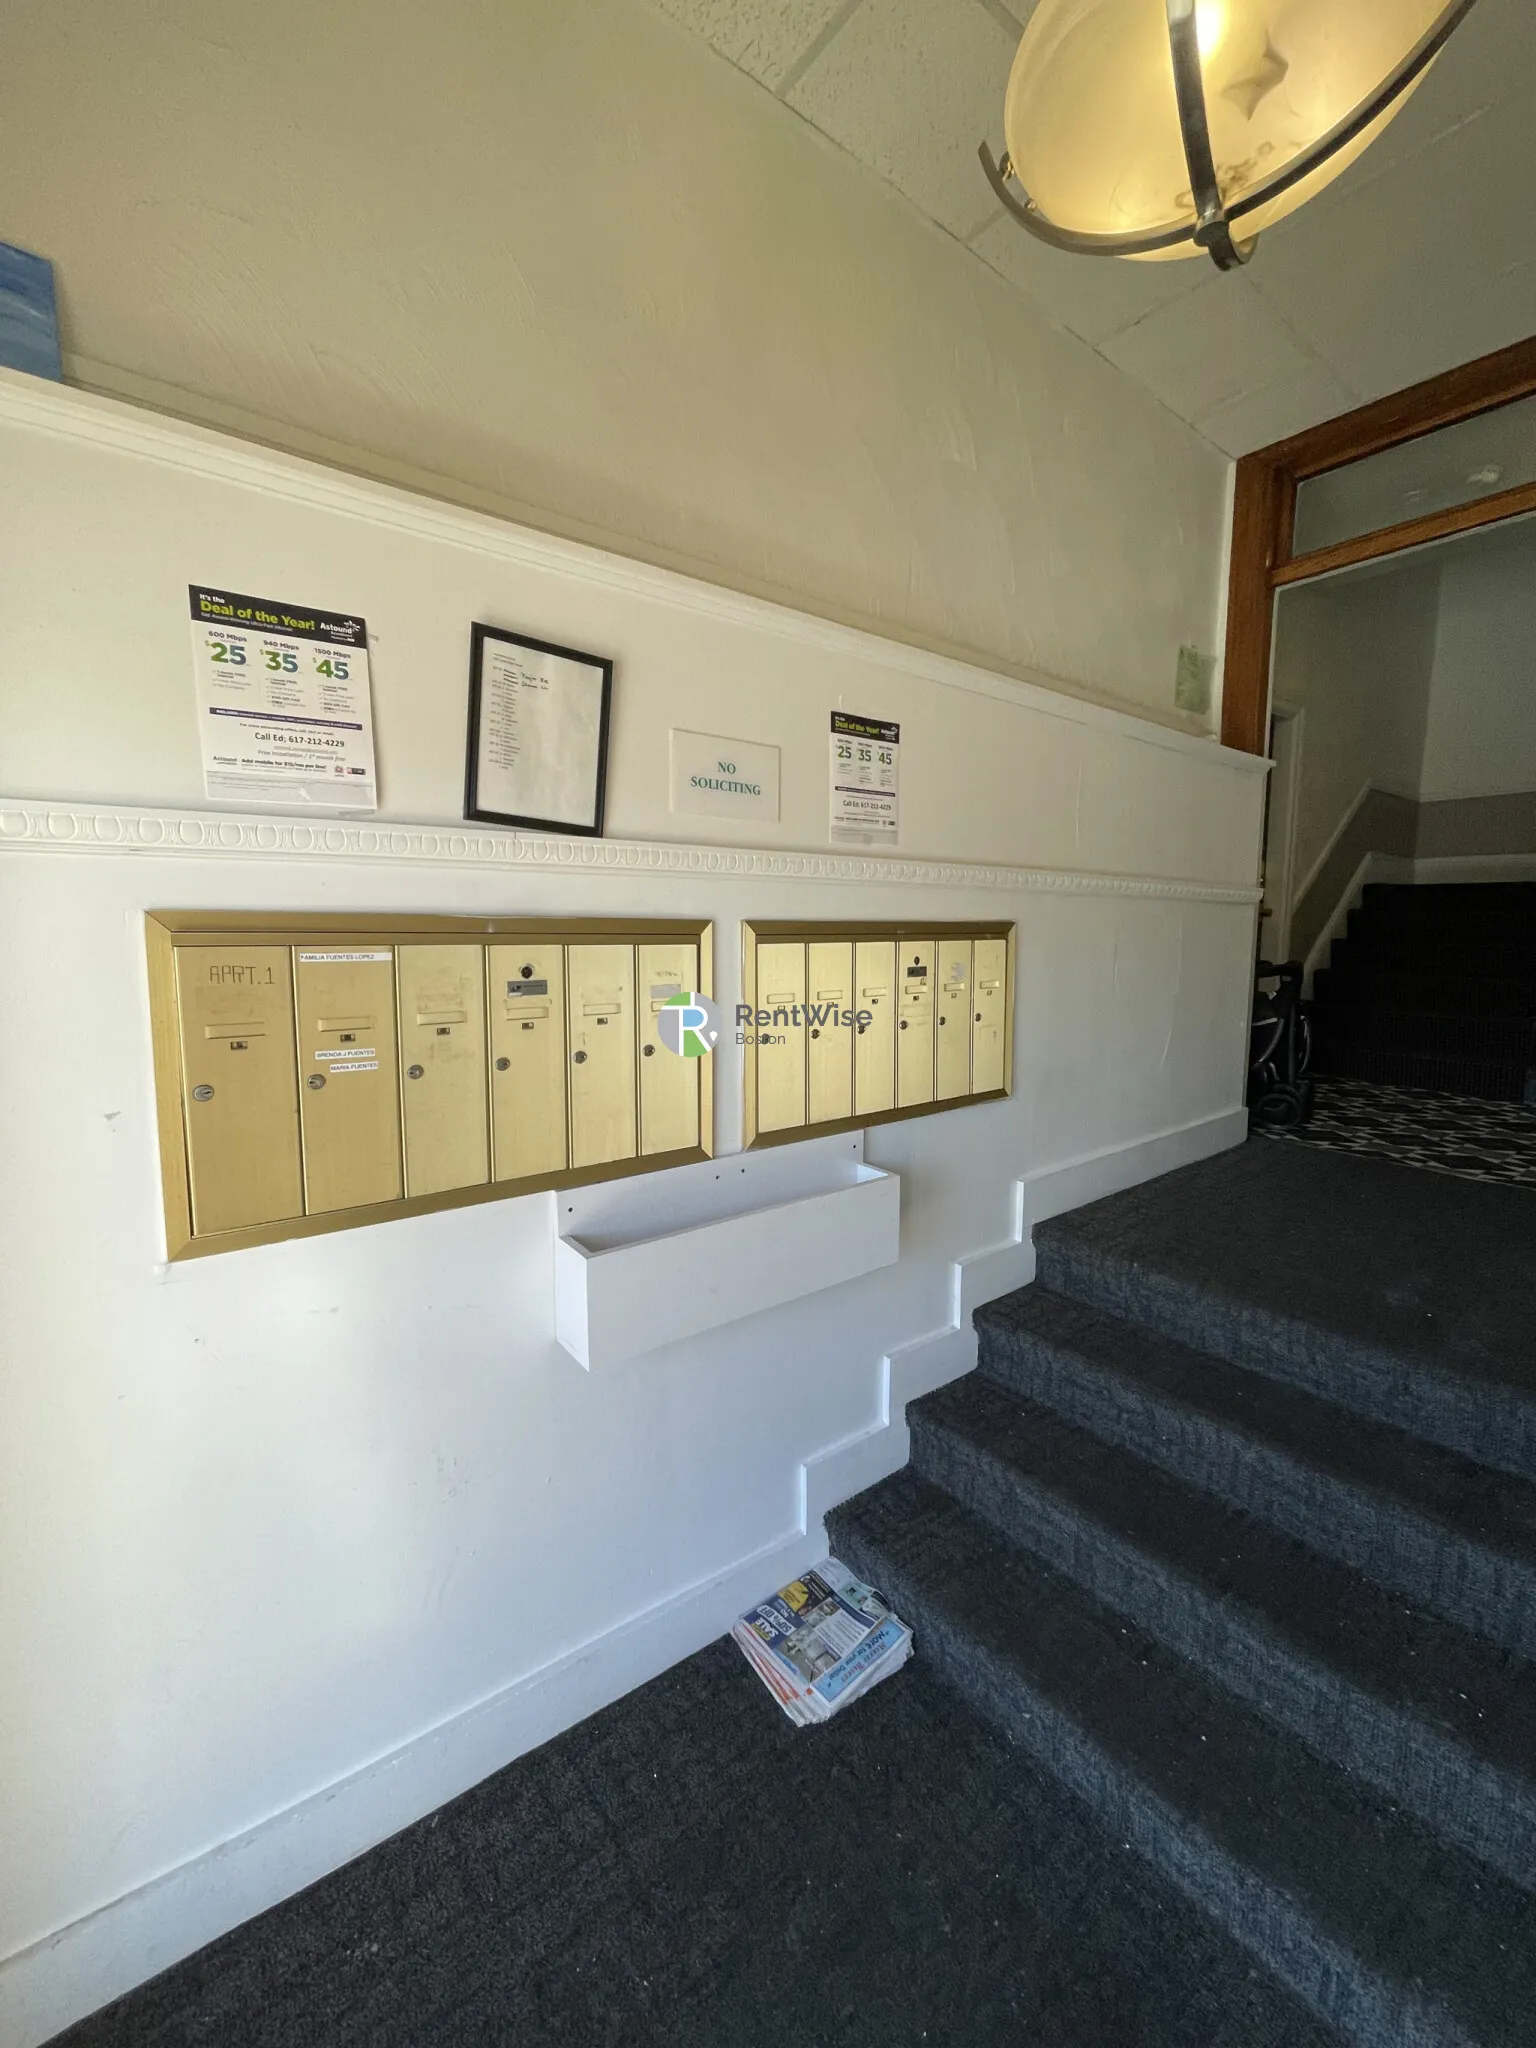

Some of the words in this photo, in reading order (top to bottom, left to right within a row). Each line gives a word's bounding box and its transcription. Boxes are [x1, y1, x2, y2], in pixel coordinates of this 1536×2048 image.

[200, 593, 211, 602] It's
[212, 596, 225, 604] the
[201, 600, 234, 616] Deal
[237, 608, 252, 619] of
[255, 610, 278, 624] the
[281, 615, 316, 631] Year!
[320, 622, 353, 634] Astound
[208, 630, 225, 639] 600
[226, 633, 248, 643] Mbps
[263, 639, 279, 648] 940
[280, 642, 300, 651] Mbps
[314, 647, 332, 656] 1500
[333, 650, 351, 659] Mbps
[254, 732, 271, 741] Call
[288, 735, 345, 748] 617-212-4229
[272, 750, 304, 759] Installation
[718, 761, 737, 775] NO
[690, 775, 761, 796] SOLICITING
[755, 1617, 779, 1637] SALE
[772, 1613, 793, 1634] 50%
